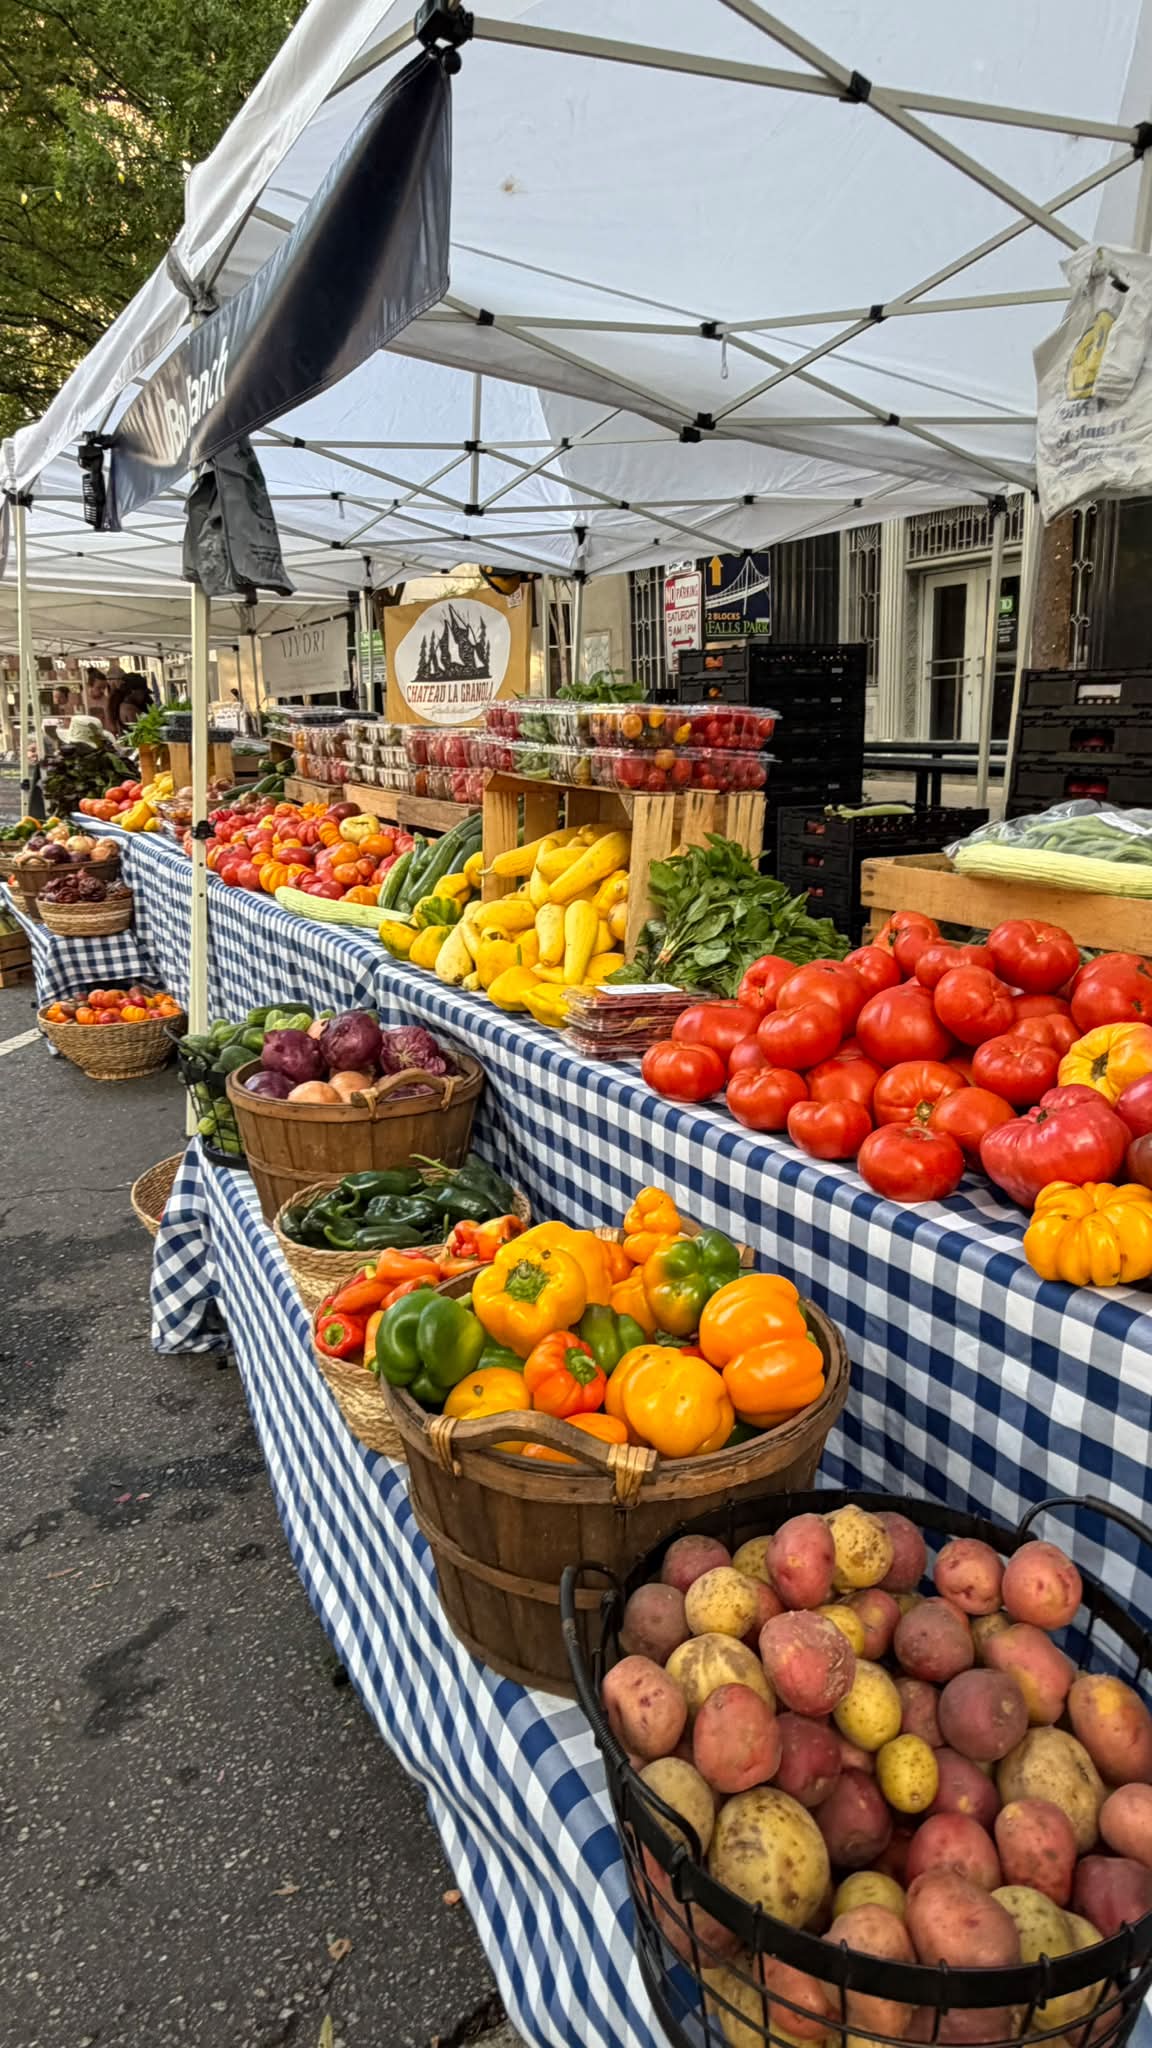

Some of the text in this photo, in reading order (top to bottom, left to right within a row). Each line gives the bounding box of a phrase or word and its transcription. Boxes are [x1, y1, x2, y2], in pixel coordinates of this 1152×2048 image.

[665, 583, 699, 602] NO PARKING
[667, 609, 697, 622] SATURDAY
[713, 612, 741, 620] BLOCKS
[707, 620, 769, 633] FALLS PARK
[406, 682, 494, 703] CHATEAU LA GRANOLA
